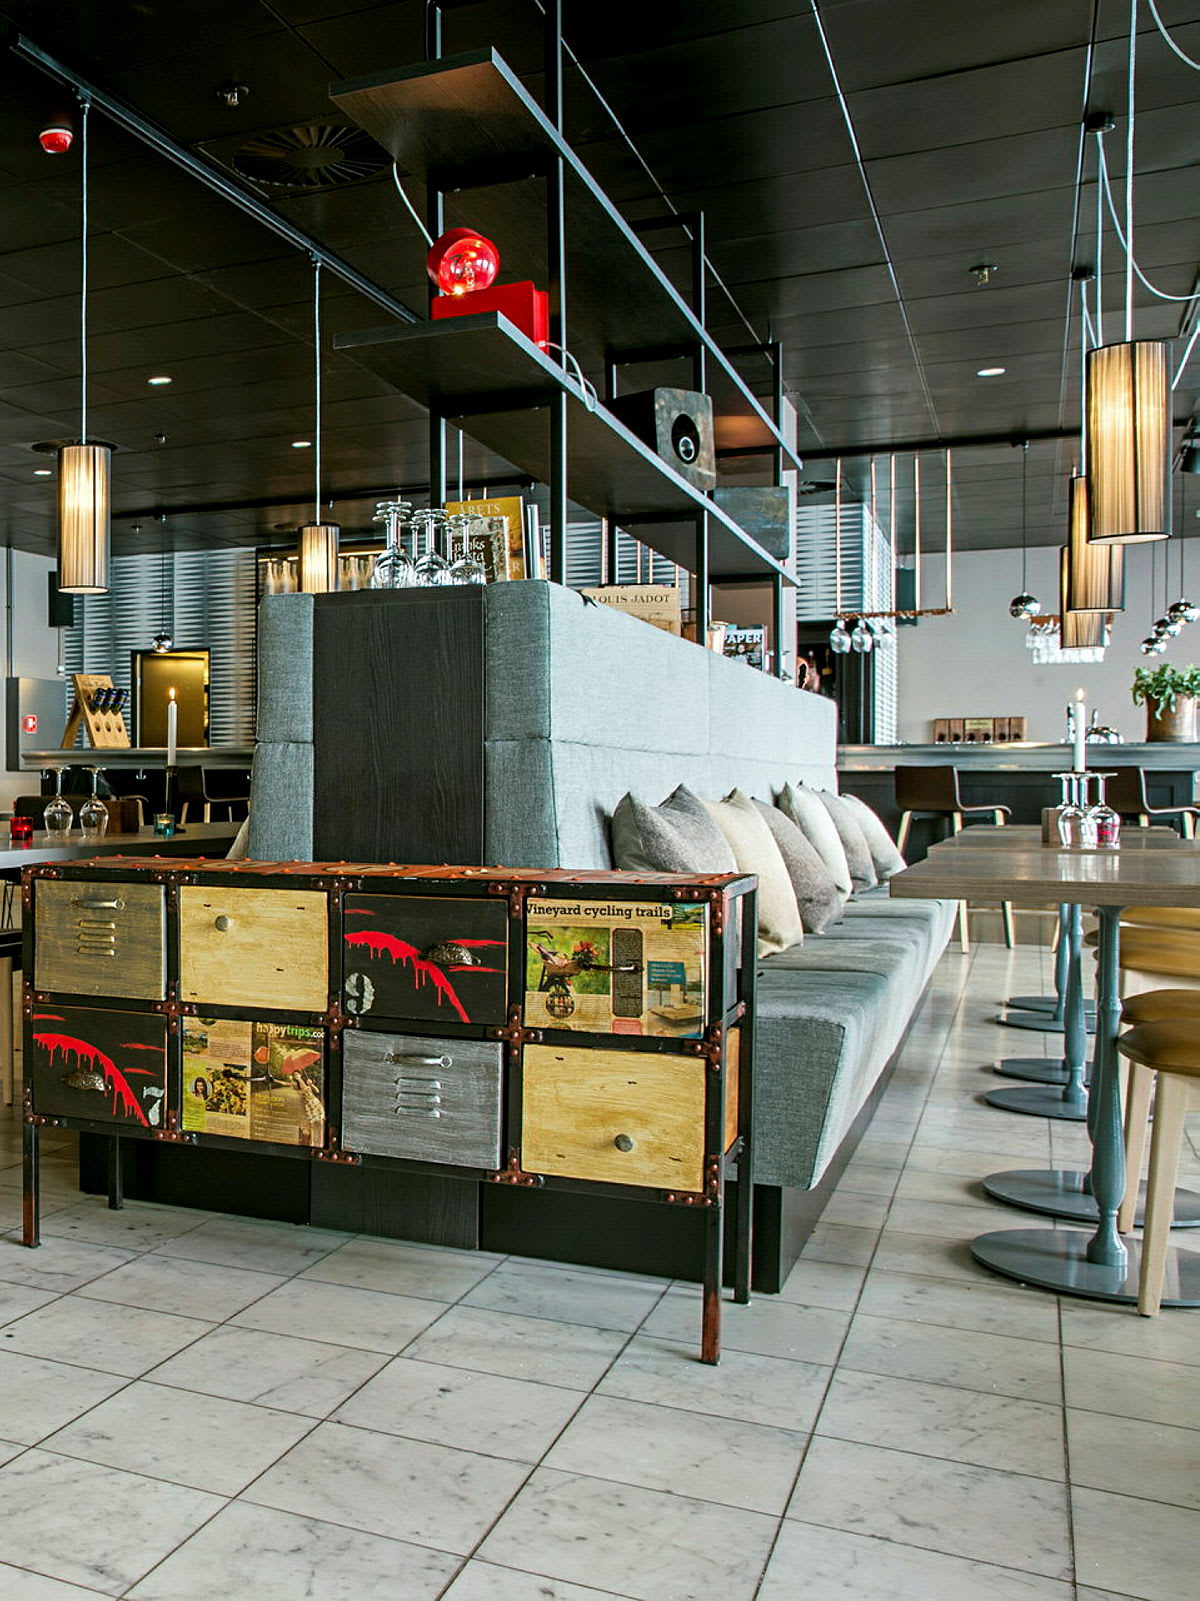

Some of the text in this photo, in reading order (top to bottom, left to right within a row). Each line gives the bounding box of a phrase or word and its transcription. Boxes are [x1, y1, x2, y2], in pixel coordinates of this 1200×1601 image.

[631, 594, 670, 604] JADOT
[527, 903, 670, 919] Vineyard cycling trails
[345, 972, 375, 1014] 9
[142, 1086, 165, 1126] 7
